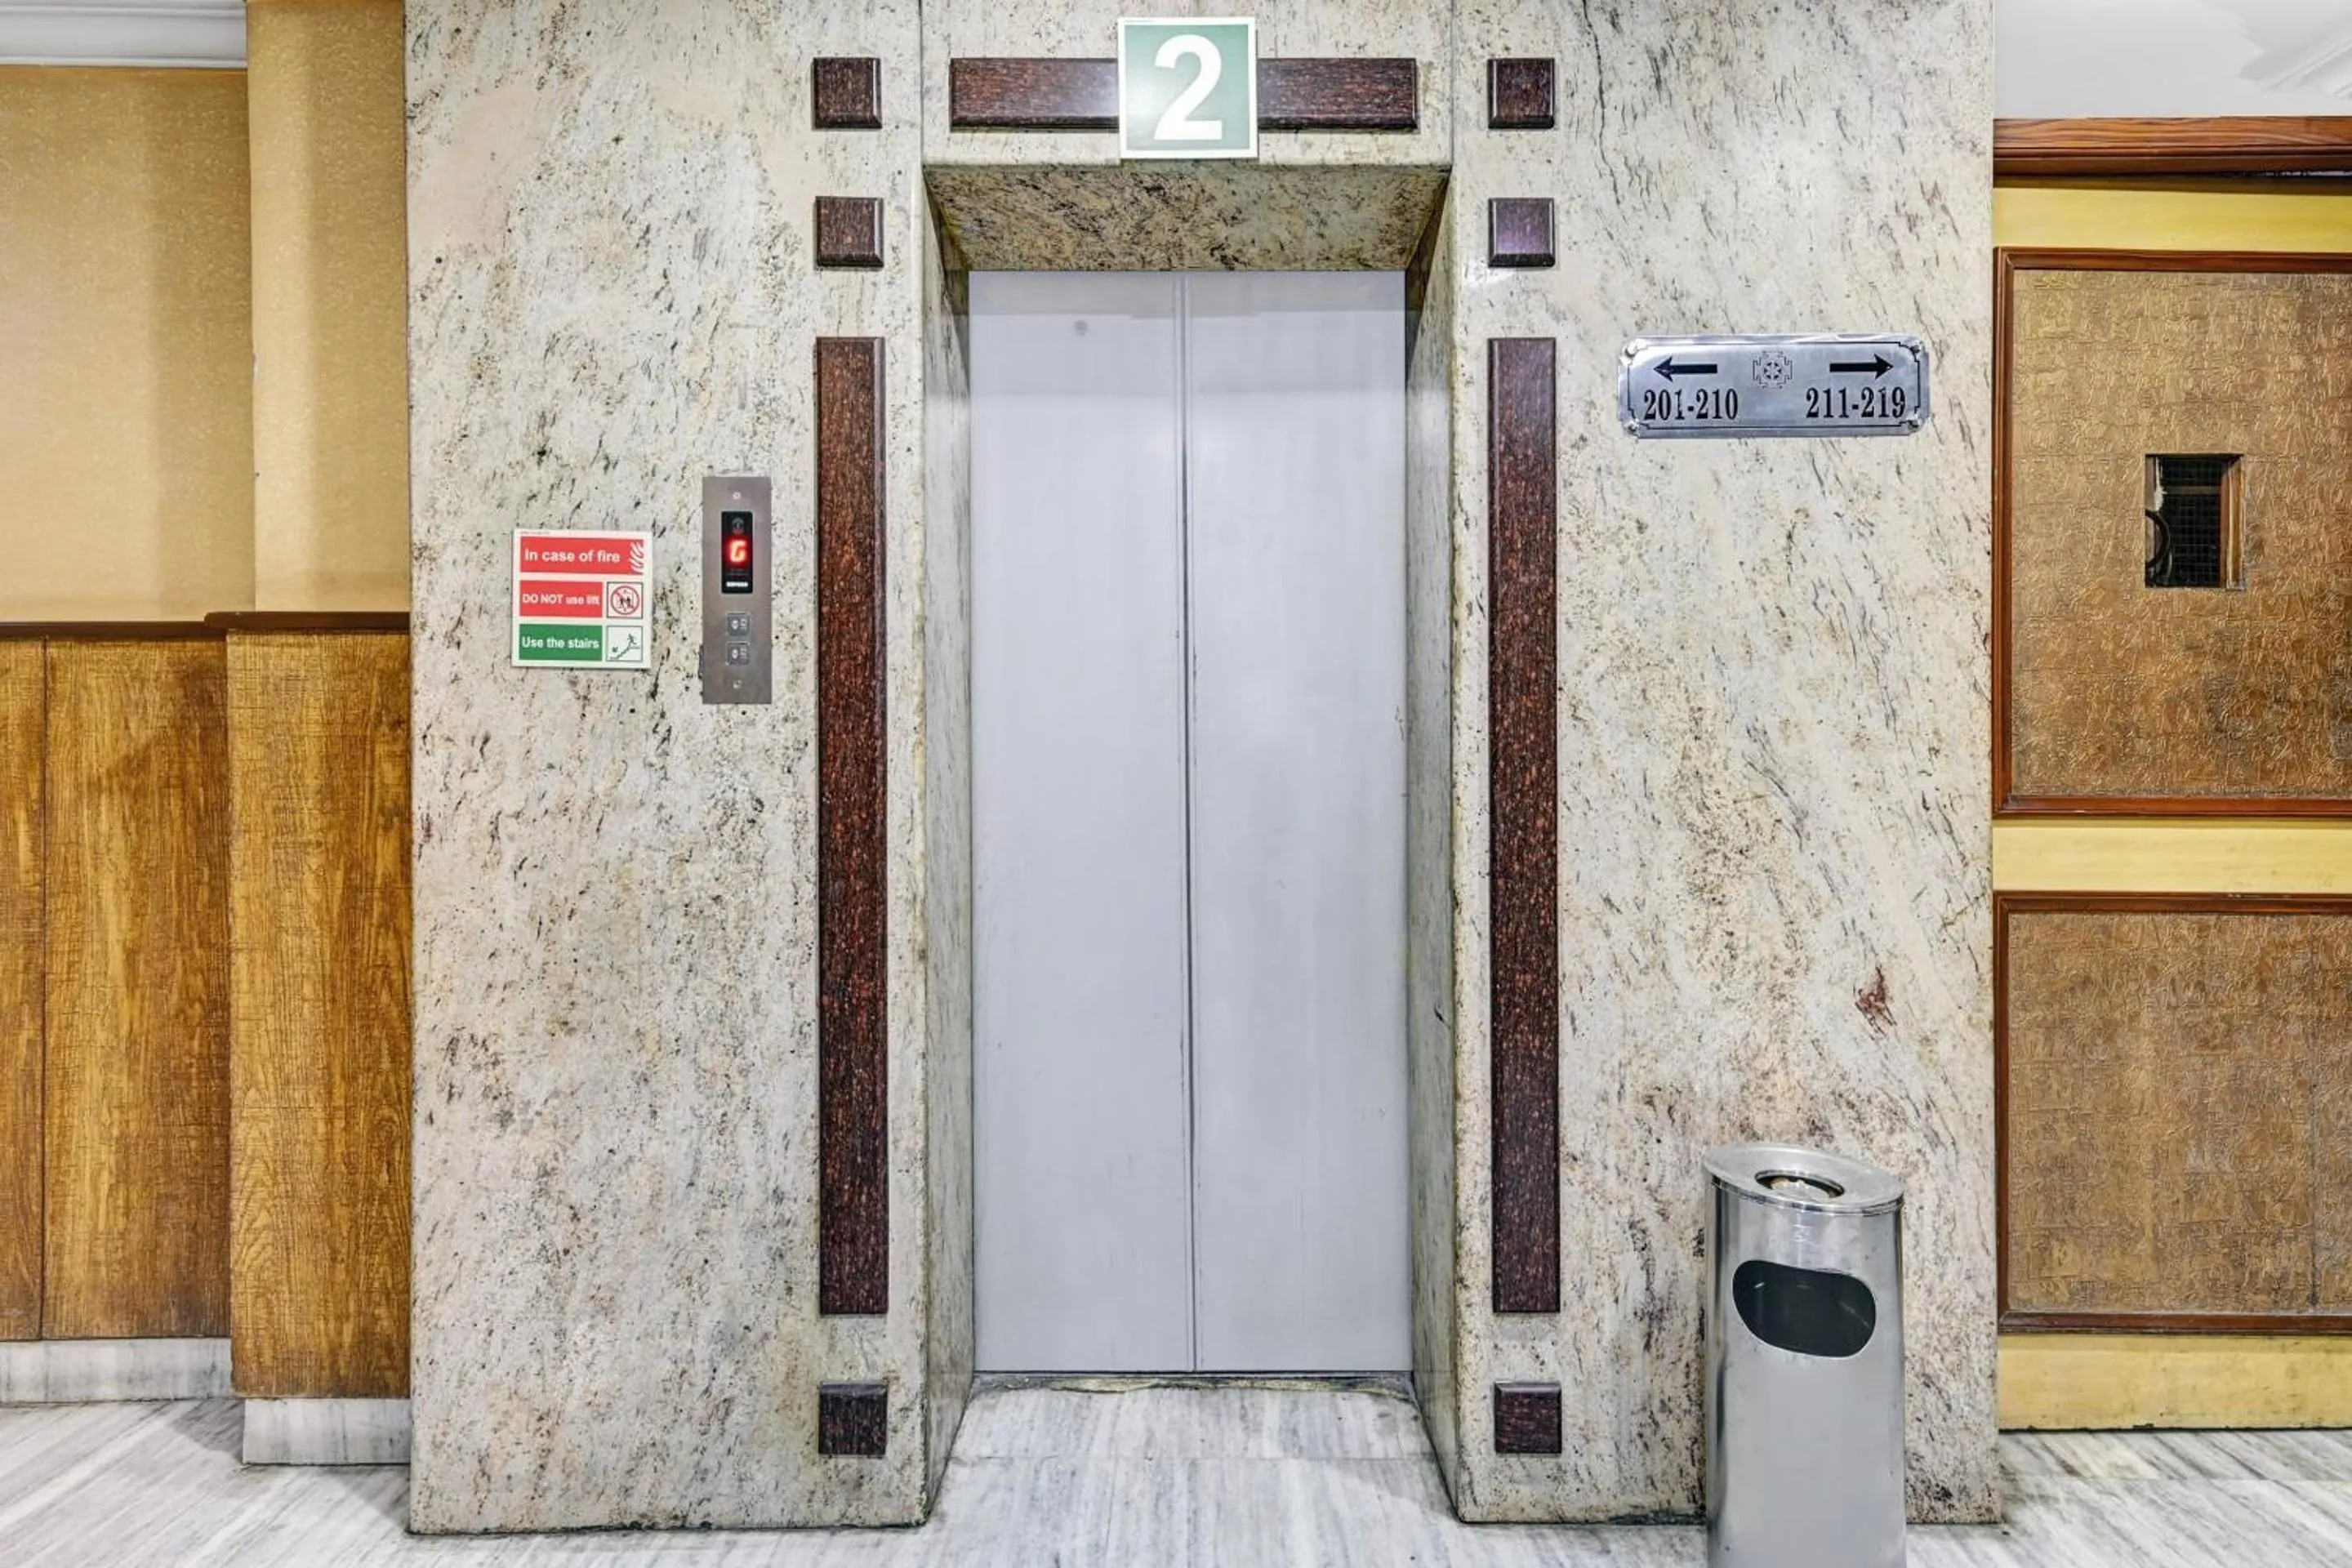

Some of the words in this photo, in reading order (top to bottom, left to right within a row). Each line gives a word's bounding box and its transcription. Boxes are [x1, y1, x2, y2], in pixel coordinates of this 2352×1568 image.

[1154, 34, 1223, 140] 2
[1643, 388, 1739, 421] 201-210
[1806, 386, 1906, 419] 211-219
[524, 548, 538, 561] In
[541, 550, 575, 562] case
[579, 550, 595, 563] of
[597, 550, 621, 563] fire
[522, 594, 539, 604] DO
[540, 594, 564, 604] NOT
[566, 596, 584, 605] use
[586, 595, 600, 605] lift
[522, 636, 543, 648] Use
[546, 637, 565, 648] the
[568, 638, 599, 649] stairs
